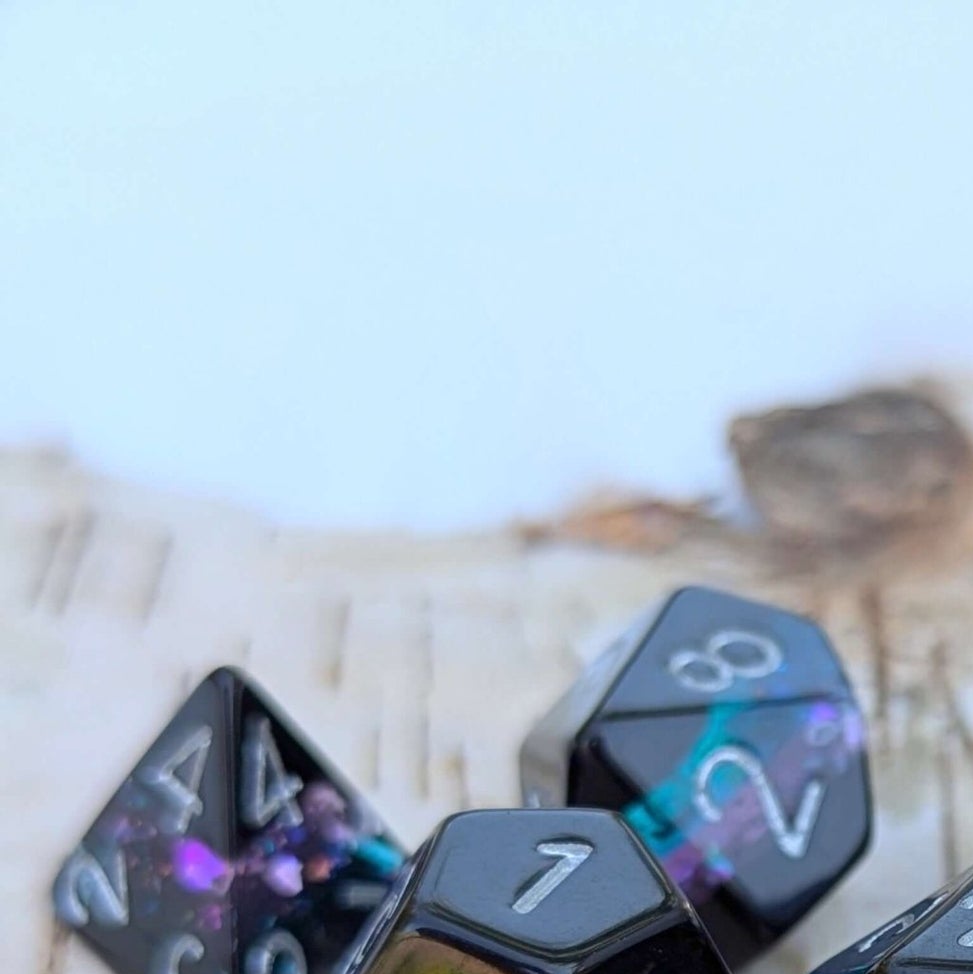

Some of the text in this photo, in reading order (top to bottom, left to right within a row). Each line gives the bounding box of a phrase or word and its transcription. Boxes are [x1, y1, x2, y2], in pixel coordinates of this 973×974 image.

[667, 628, 785, 694] 8
[139, 724, 213, 833] 4
[238, 716, 303, 826] 4
[693, 745, 826, 858] 2
[53, 845, 130, 928] 2
